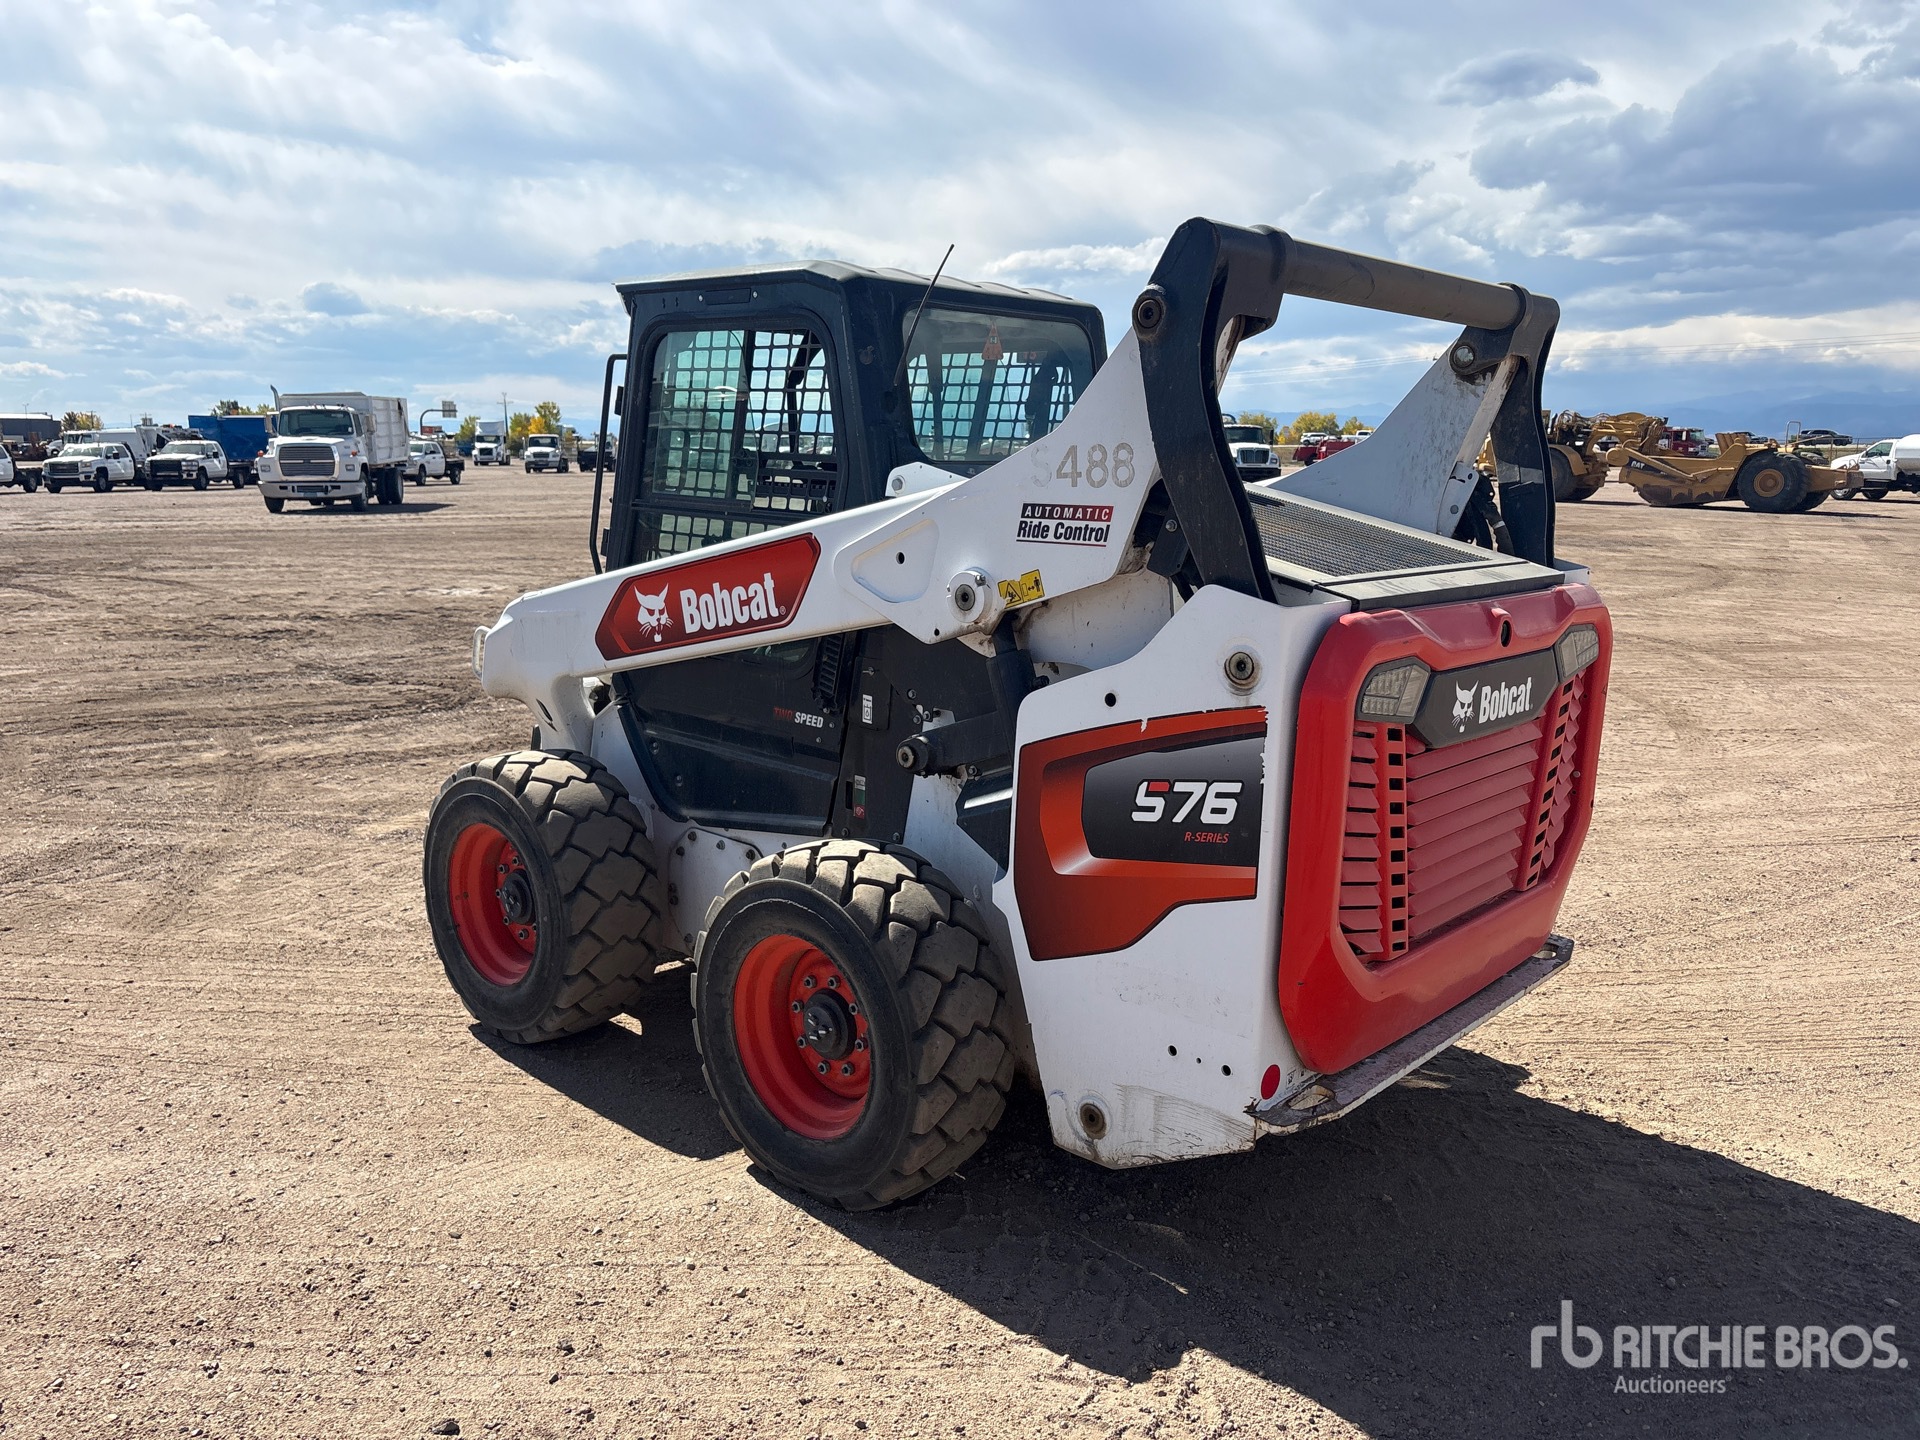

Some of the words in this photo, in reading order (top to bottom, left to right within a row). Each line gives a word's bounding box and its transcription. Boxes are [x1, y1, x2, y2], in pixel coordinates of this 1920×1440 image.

[1024, 506, 1110, 521] AUTOMATIC
[1017, 520, 1050, 539] Ride
[1053, 522, 1111, 543] Control
[679, 572, 779, 634] Bobcat
[1478, 676, 1532, 724] Bobcat
[794, 711, 824, 728] SPEED
[1131, 781, 1243, 825] S76
[1184, 831, 1229, 843] R-SERIES
